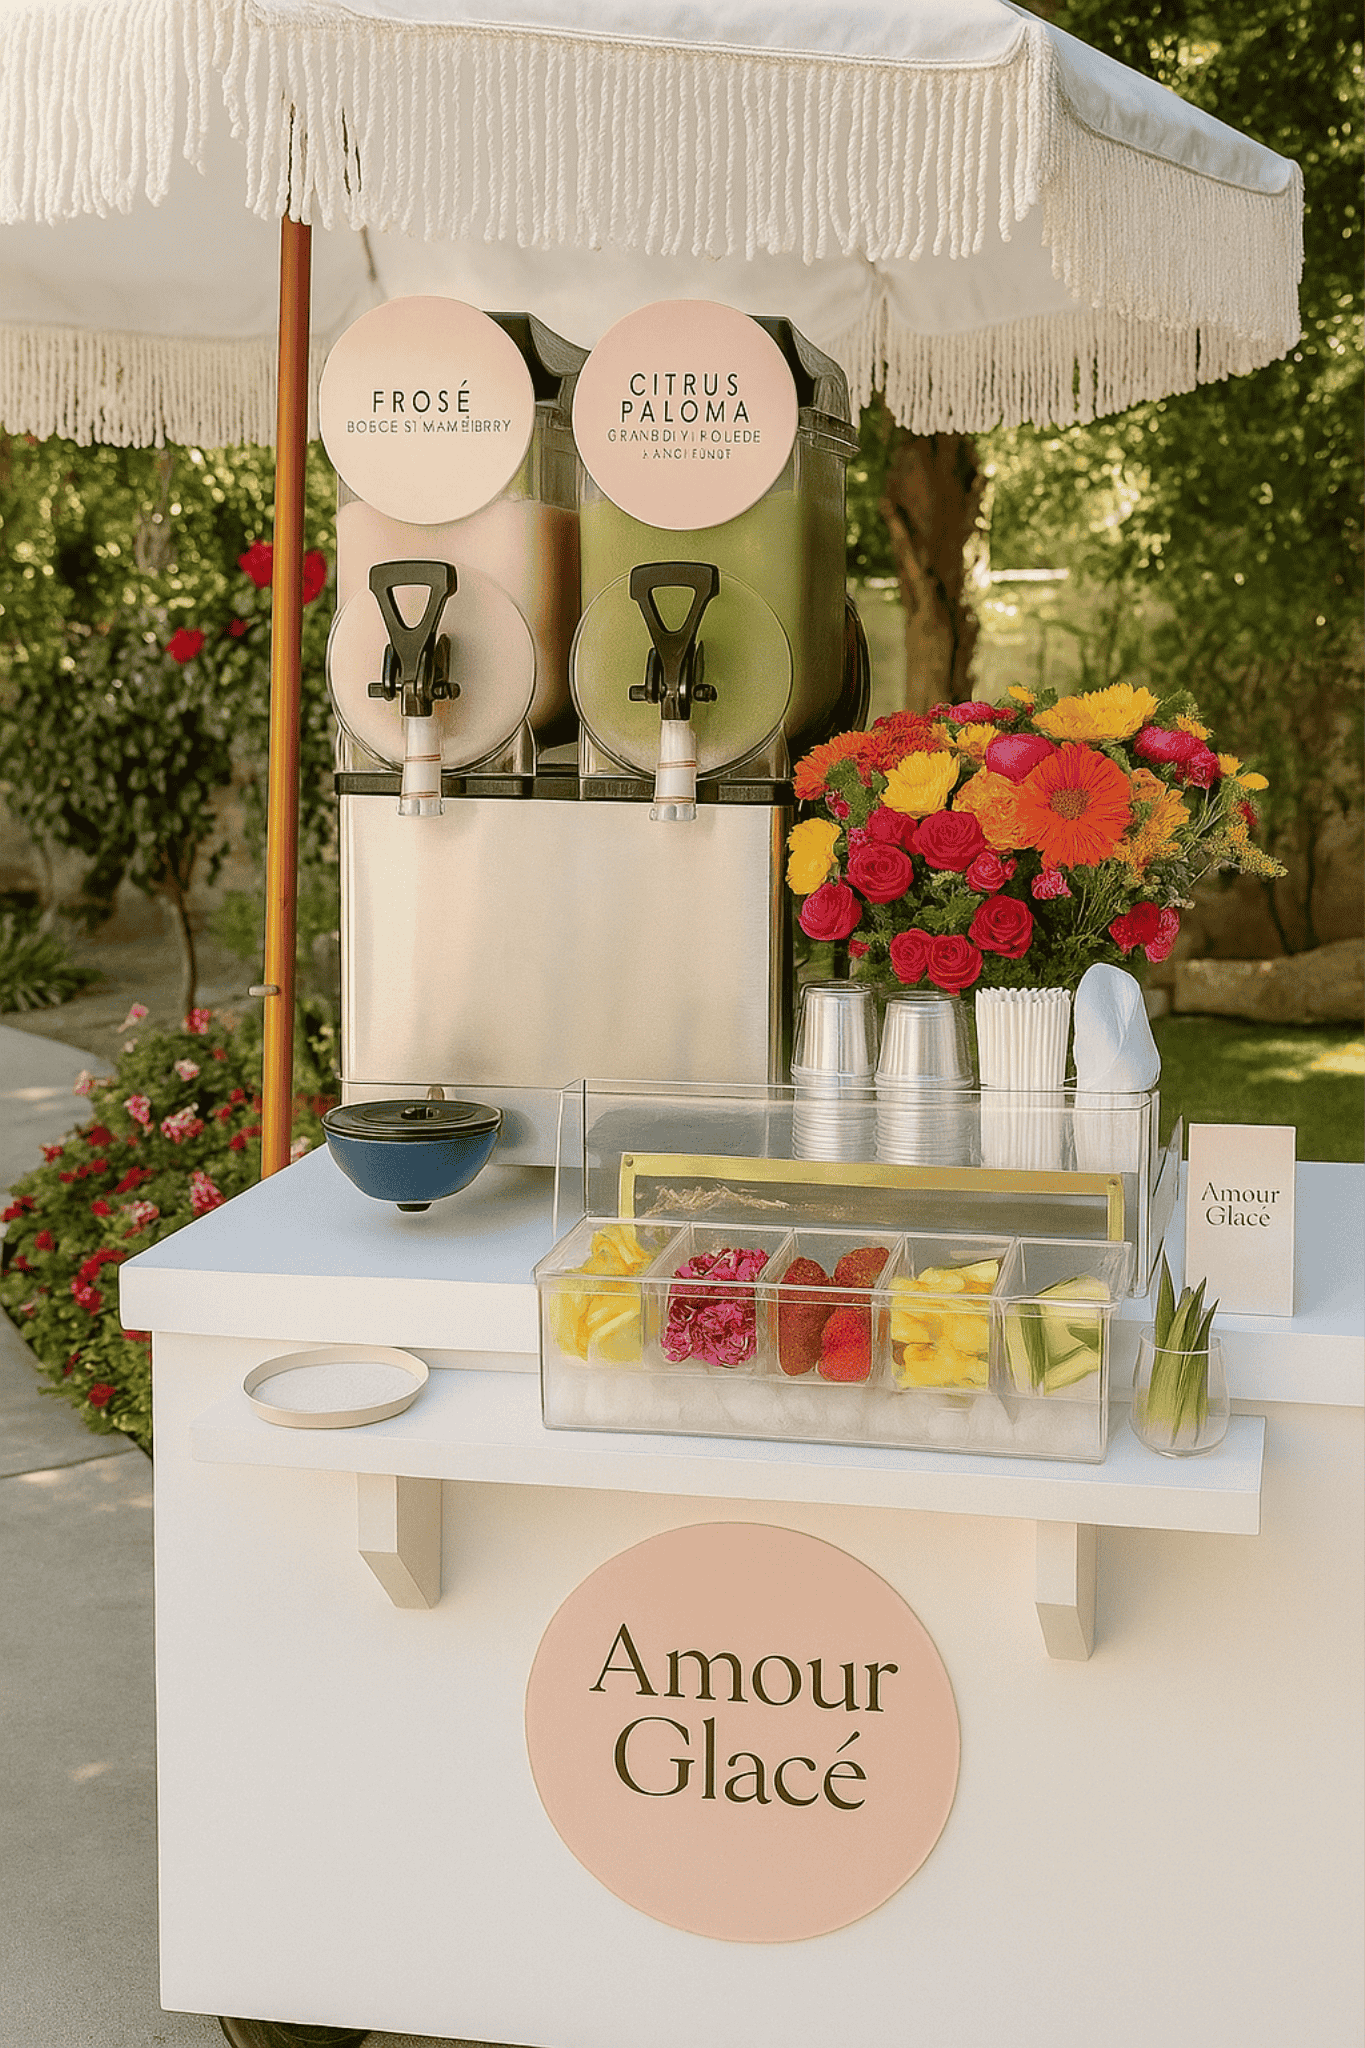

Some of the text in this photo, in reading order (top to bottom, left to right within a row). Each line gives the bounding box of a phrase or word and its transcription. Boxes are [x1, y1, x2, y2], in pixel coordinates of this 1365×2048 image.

[372, 379, 471, 414] FROSÉ
[629, 372, 739, 397] CITRUS
[620, 399, 750, 424] PALOMA
[1201, 1181, 1281, 1204] Amour
[1205, 1205, 1271, 1229] Glacé
[588, 1623, 900, 1714] Amour
[613, 1716, 868, 1811] Glacé
